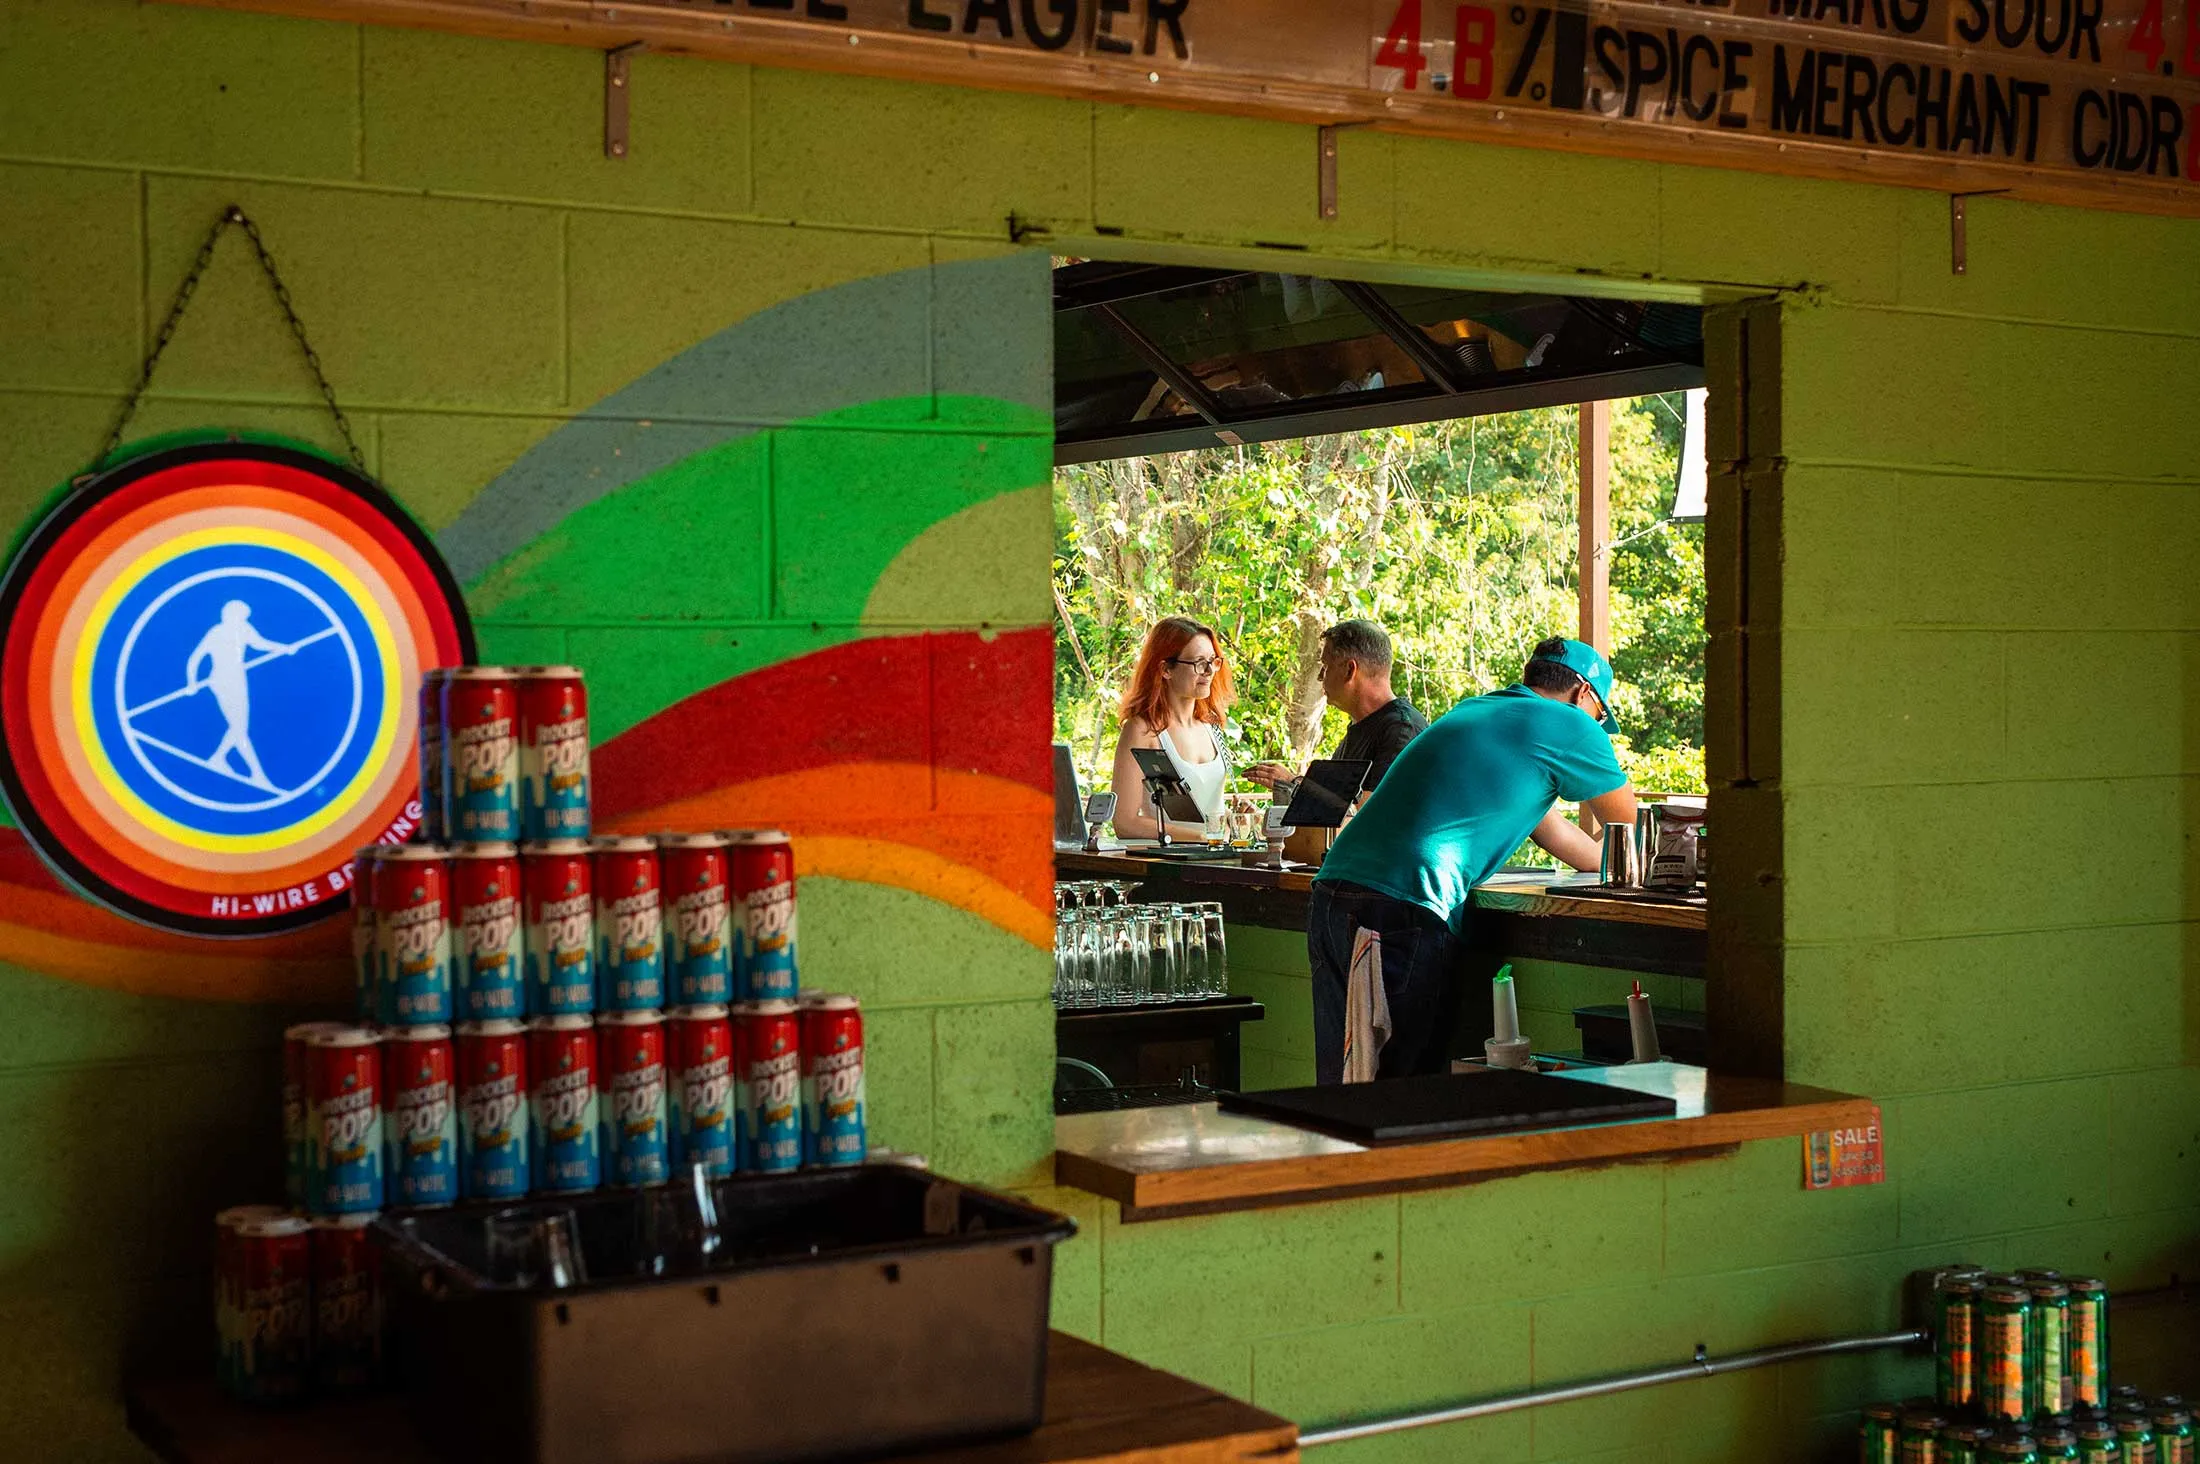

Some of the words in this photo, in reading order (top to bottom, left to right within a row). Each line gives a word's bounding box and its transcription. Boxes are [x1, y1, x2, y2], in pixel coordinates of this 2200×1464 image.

[1591, 25, 1753, 129] SPICE
[1770, 44, 2049, 163] MERCHANT
[2073, 89, 2184, 177] CIDR
[462, 737, 512, 777] POP
[543, 737, 587, 777] POP
[211, 882, 320, 915] HI-WIRE
[467, 915, 514, 954] POP
[547, 912, 591, 952] POP
[617, 907, 660, 945] POP
[681, 903, 726, 942] POP
[751, 899, 792, 939] POP
[395, 919, 441, 962] POP
[616, 1082, 660, 1122] POP
[686, 1074, 733, 1112] POP
[755, 1069, 799, 1108] POP
[818, 1064, 862, 1102] POP
[400, 1100, 449, 1137] POP
[470, 1093, 517, 1133] POP
[541, 1085, 590, 1125] POP
[324, 1106, 373, 1150] POP
[1833, 1126, 1878, 1146] SALE
